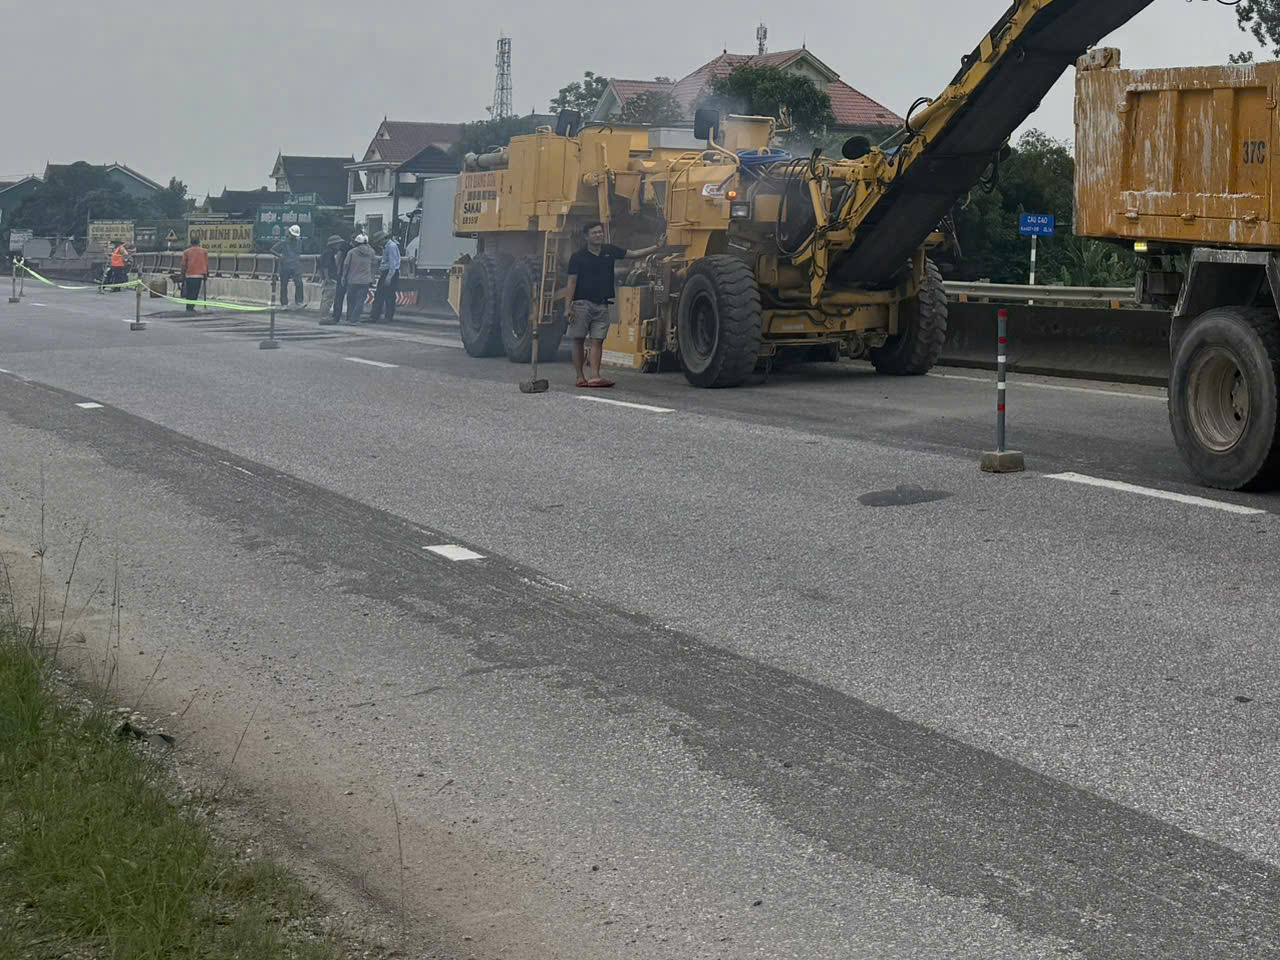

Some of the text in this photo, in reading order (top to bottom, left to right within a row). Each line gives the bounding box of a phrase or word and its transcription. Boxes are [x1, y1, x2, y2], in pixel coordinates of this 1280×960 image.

[1242, 140, 1265, 165] 37C
[463, 201, 482, 214] SAKAI
[232, 225, 251, 241] DÂN
